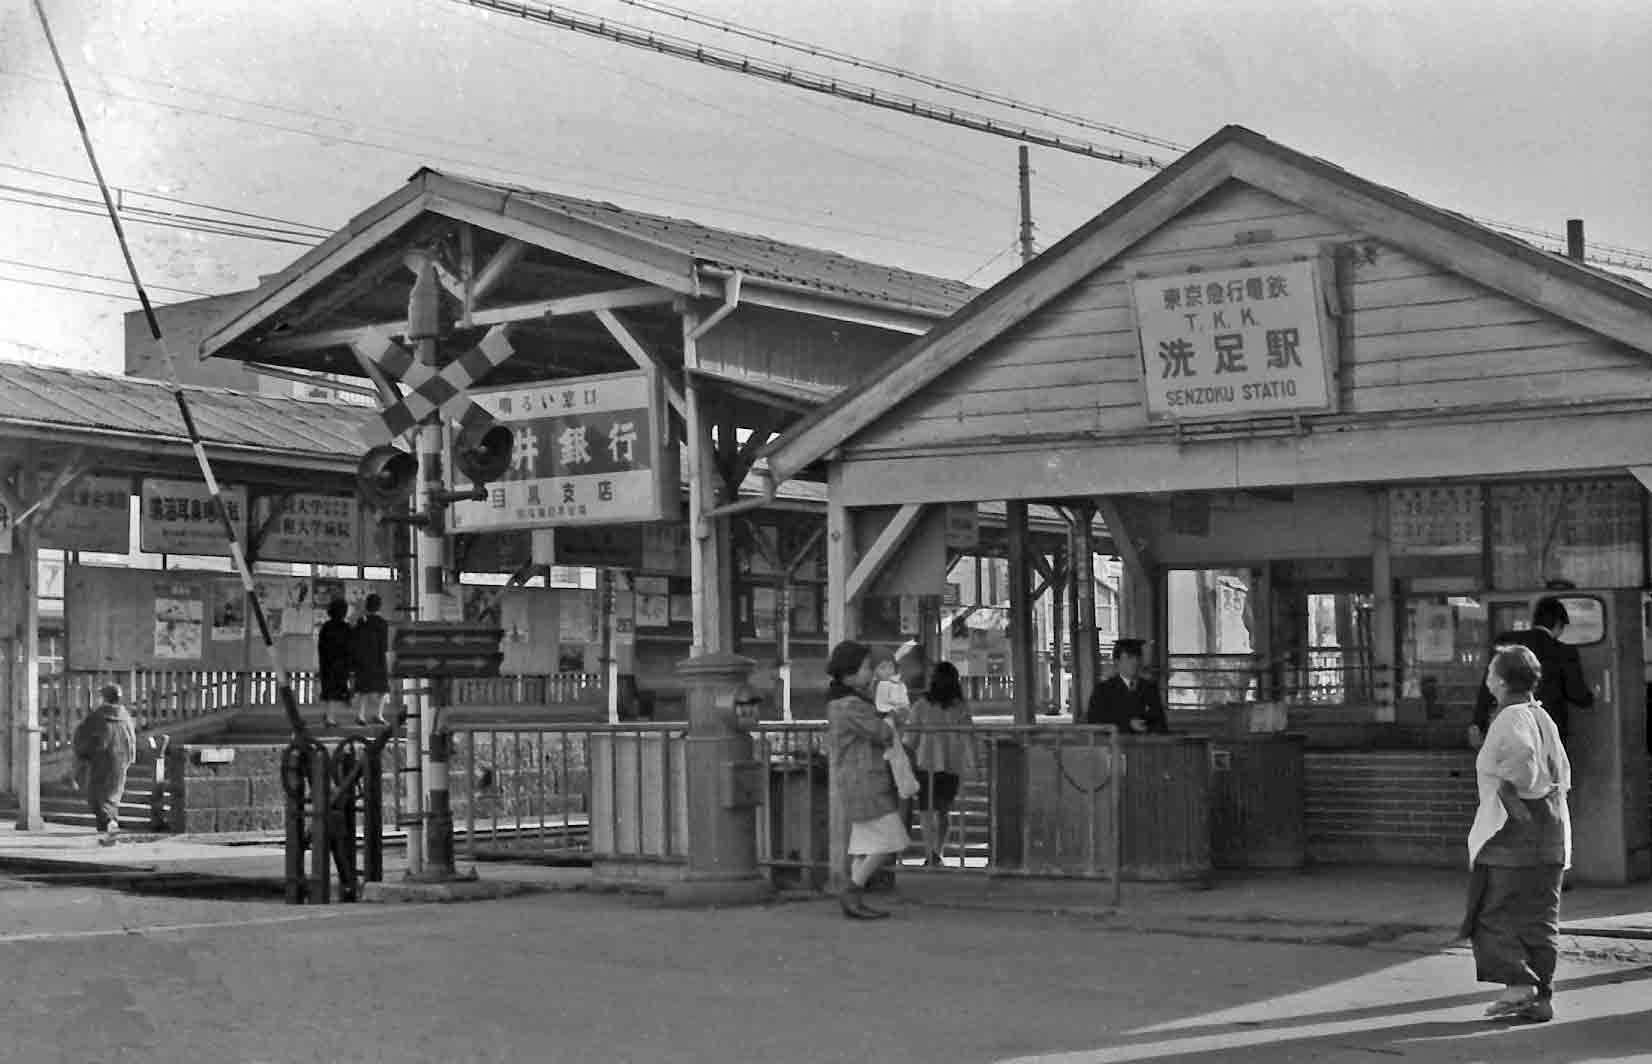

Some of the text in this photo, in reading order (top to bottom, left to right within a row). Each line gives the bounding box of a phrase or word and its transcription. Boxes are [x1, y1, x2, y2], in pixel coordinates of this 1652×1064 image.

[1162, 274, 1288, 310] 東京急行電鉄
[1158, 327, 1302, 379] 洗足駅
[1165, 379, 1296, 407] SENZOKU STATIO
[512, 421, 637, 472] 井銀行
